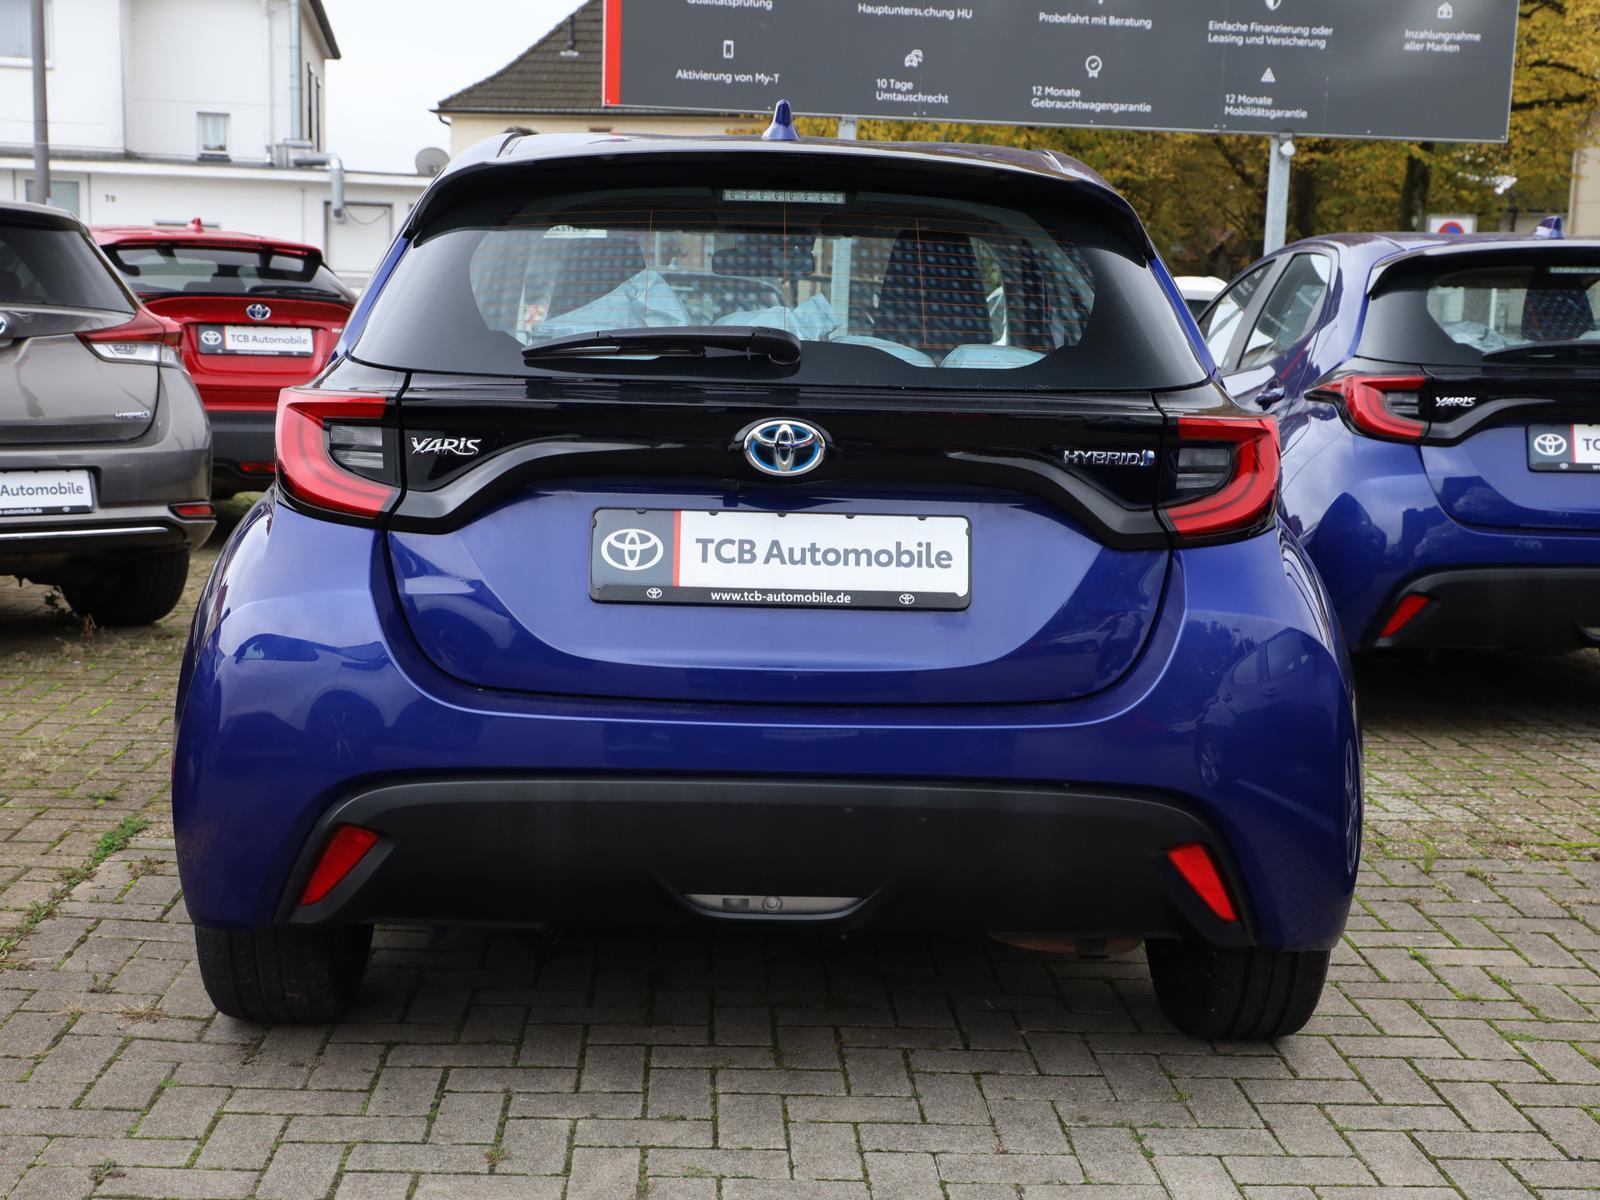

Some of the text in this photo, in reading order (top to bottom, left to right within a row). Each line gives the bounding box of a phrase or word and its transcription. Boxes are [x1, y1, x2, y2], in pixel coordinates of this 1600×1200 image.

[957, 9, 973, 19] HU
[1039, 12, 1152, 29] Probefahrt mit Beratung
[1208, 20, 1333, 37] Einfache Finanzierung oder
[1404, 29, 1481, 42] Inzahlungnahme
[1208, 33, 1326, 50] Leasing und Versicherung
[1404, 41, 1460, 52] aller Marken
[676, 69, 780, 85] Aktivierung von My-T
[876, 78, 914, 91] 10 Tage
[1032, 86, 1081, 97] 12 Monate
[876, 91, 949, 104] Umtauschrecht
[1225, 94, 1273, 105] 12 Monate
[1031, 98, 1152, 113] Gebrauchtwagengarantie
[1224, 105, 1308, 120] Mobilitätsgarantie
[230, 334, 308, 345] TCB Automobile
[1435, 397, 1476, 407] YARIS
[411, 437, 481, 456] YARIS
[1064, 450, 1141, 465] HYBRID
[0, 482, 84, 497] Automobile
[695, 538, 953, 569] TCB Automobile
[711, 590, 851, 603] www.tcb-automobile.de
